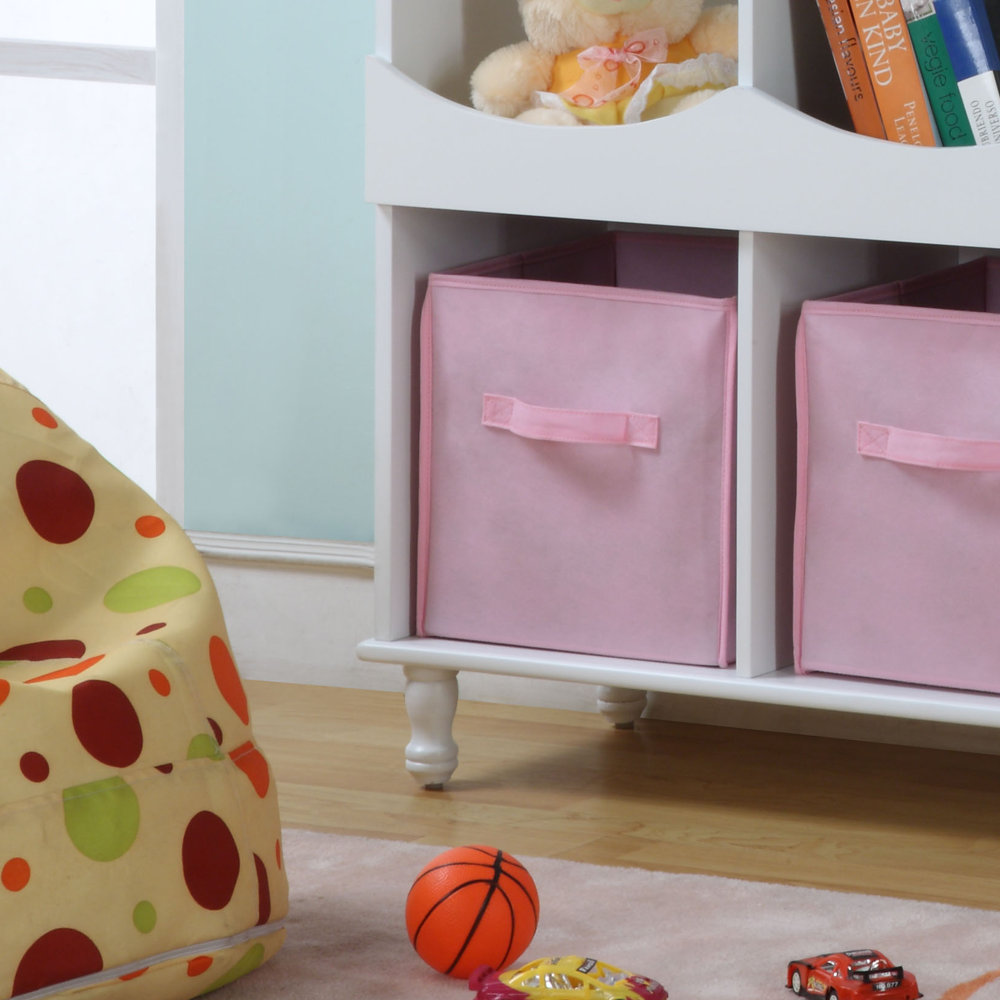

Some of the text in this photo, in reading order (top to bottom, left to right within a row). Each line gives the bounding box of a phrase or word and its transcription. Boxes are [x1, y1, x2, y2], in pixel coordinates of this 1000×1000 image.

[839, 36, 864, 102] flavours
[863, 23, 893, 87] KIND
[921, 31, 968, 141] vegie food
